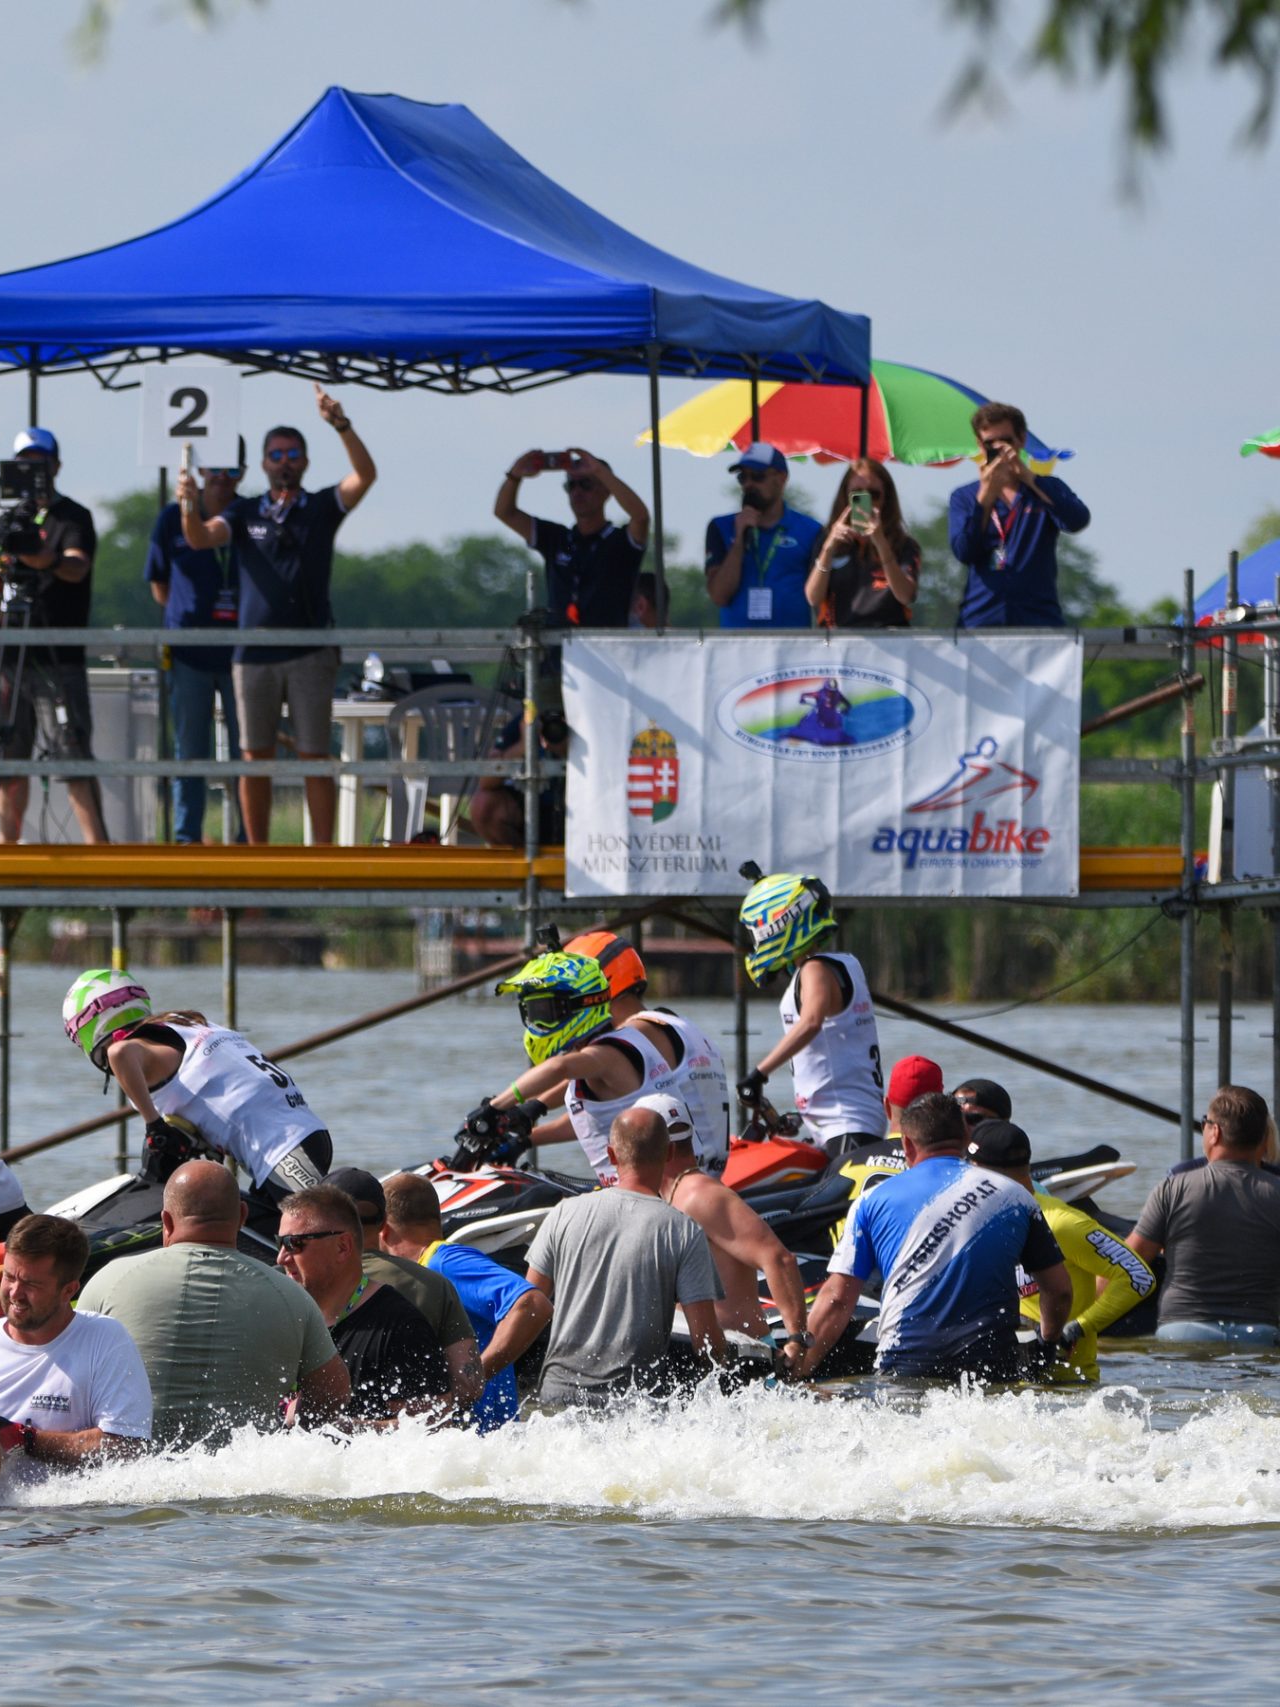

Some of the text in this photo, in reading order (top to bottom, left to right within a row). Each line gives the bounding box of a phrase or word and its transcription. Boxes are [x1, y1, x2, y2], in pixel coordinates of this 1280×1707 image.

[169, 387, 209, 437] 2
[588, 832, 722, 851] HONVÉDELMI
[872, 810, 1051, 870] aquabike
[584, 855, 729, 873] MINISZTÉRIUM
